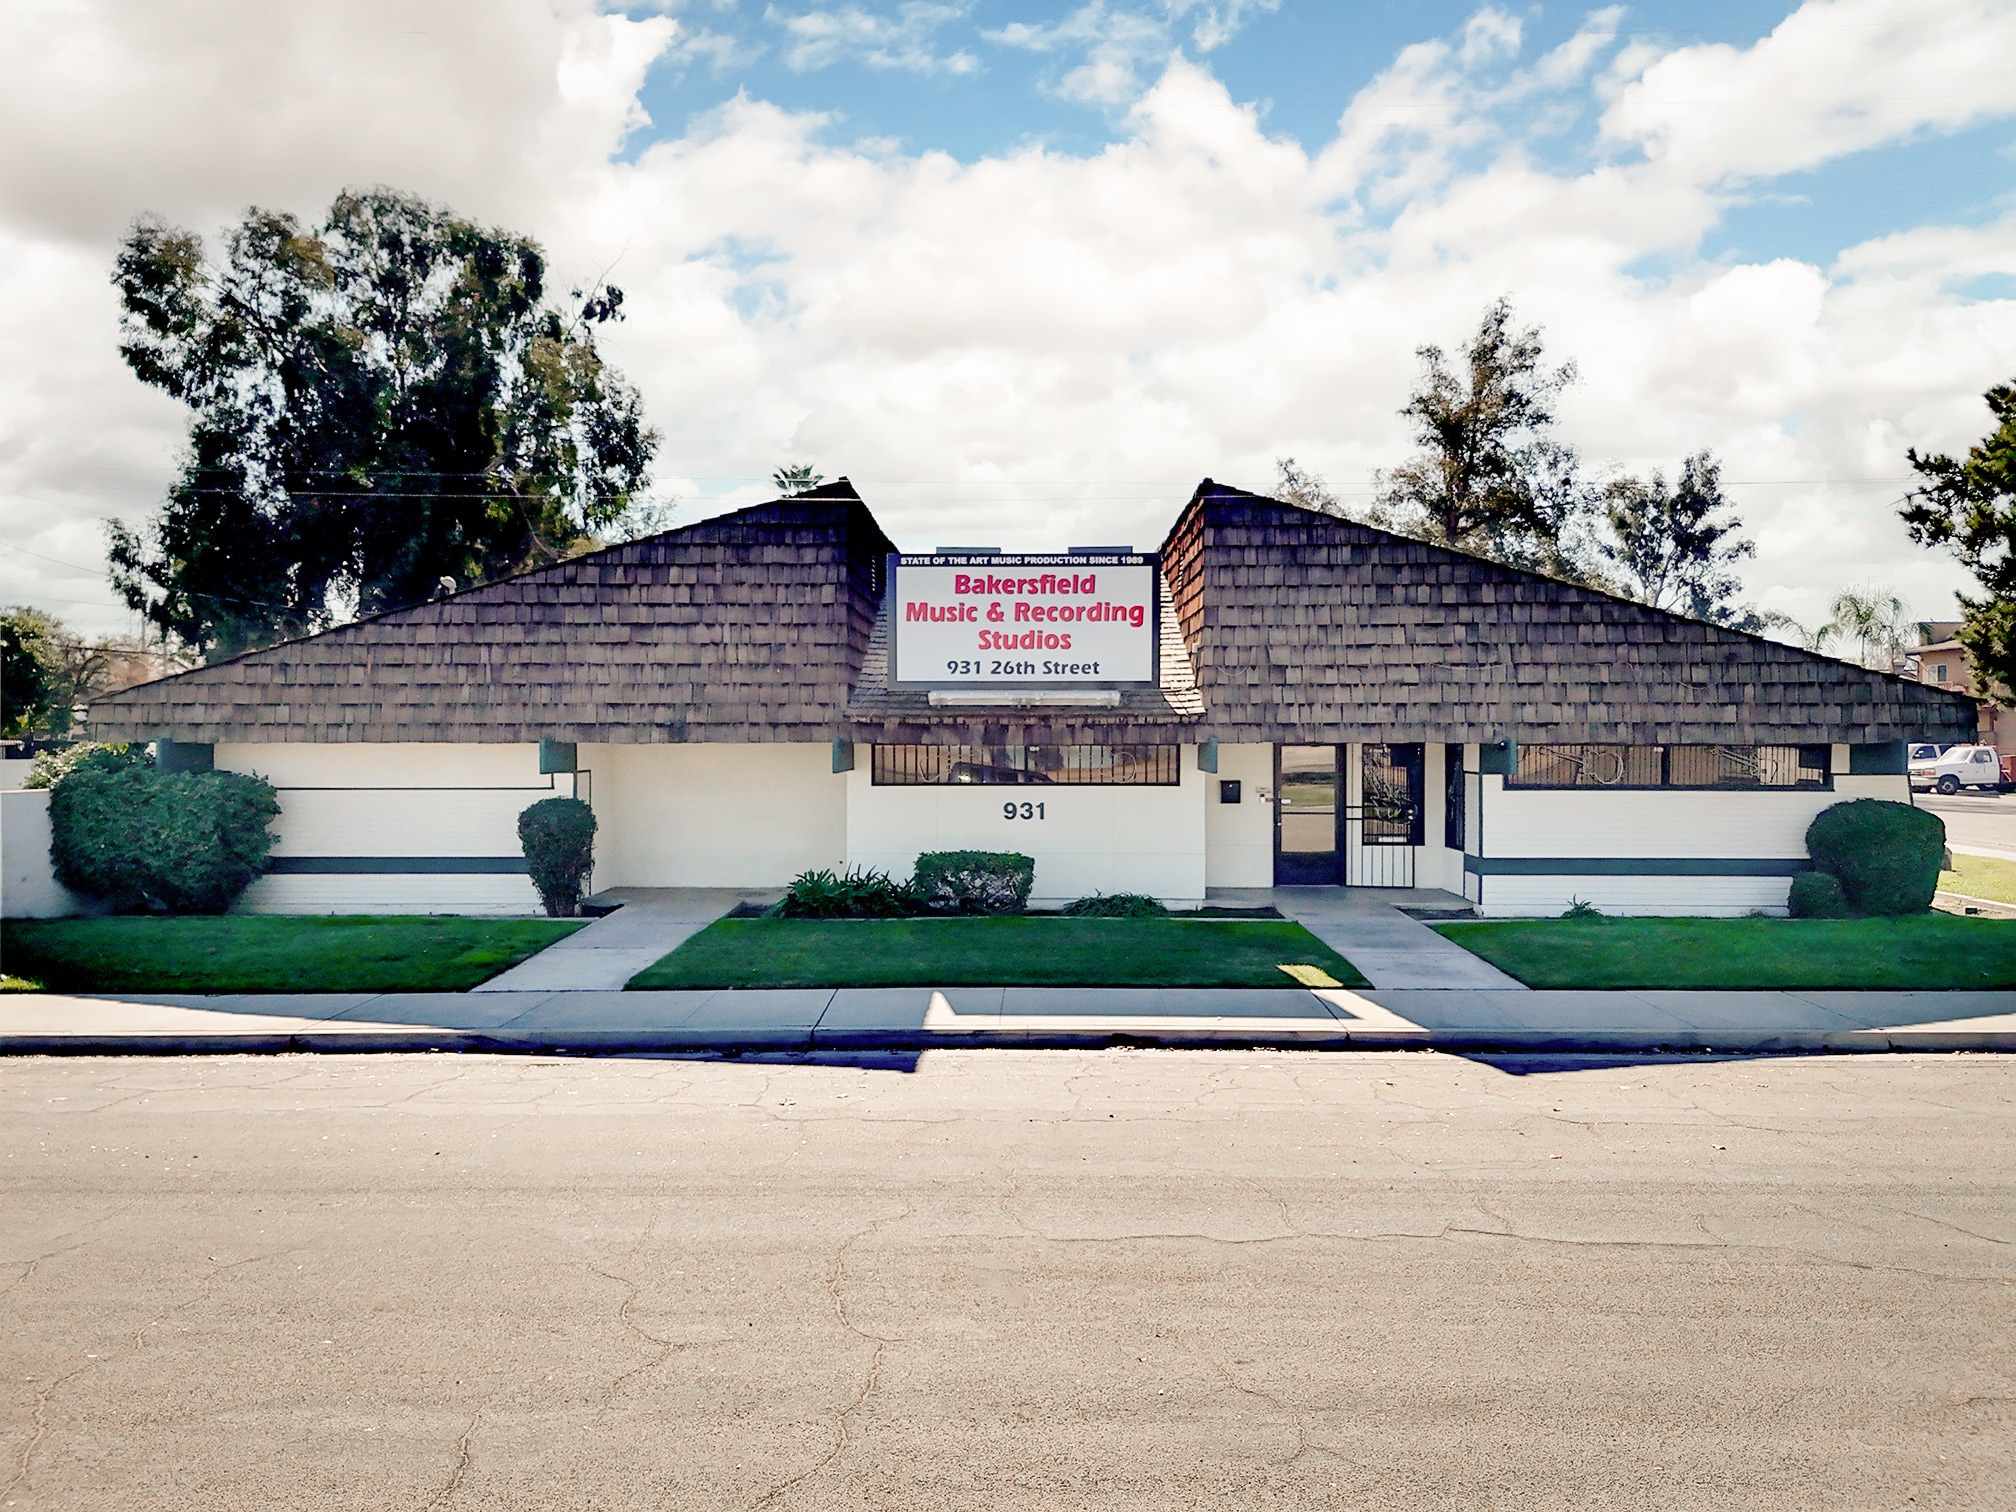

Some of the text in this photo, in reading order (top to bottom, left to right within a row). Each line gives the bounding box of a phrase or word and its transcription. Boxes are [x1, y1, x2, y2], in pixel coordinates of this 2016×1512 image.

[900, 557, 931, 565] STATE
[932, 557, 946, 565] OF
[947, 557, 967, 565] THE
[969, 556, 989, 565] ART
[991, 556, 1022, 565] MUSIC
[1024, 556, 1087, 564] PRODUCTION
[1089, 556, 1119, 564] SINCE
[954, 574, 1096, 594] Bakersfield
[905, 602, 1145, 628] Music & Recording
[978, 630, 1072, 650] Studios
[946, 660, 1100, 675] 931 26th Street
[1003, 801, 1045, 820] 931
